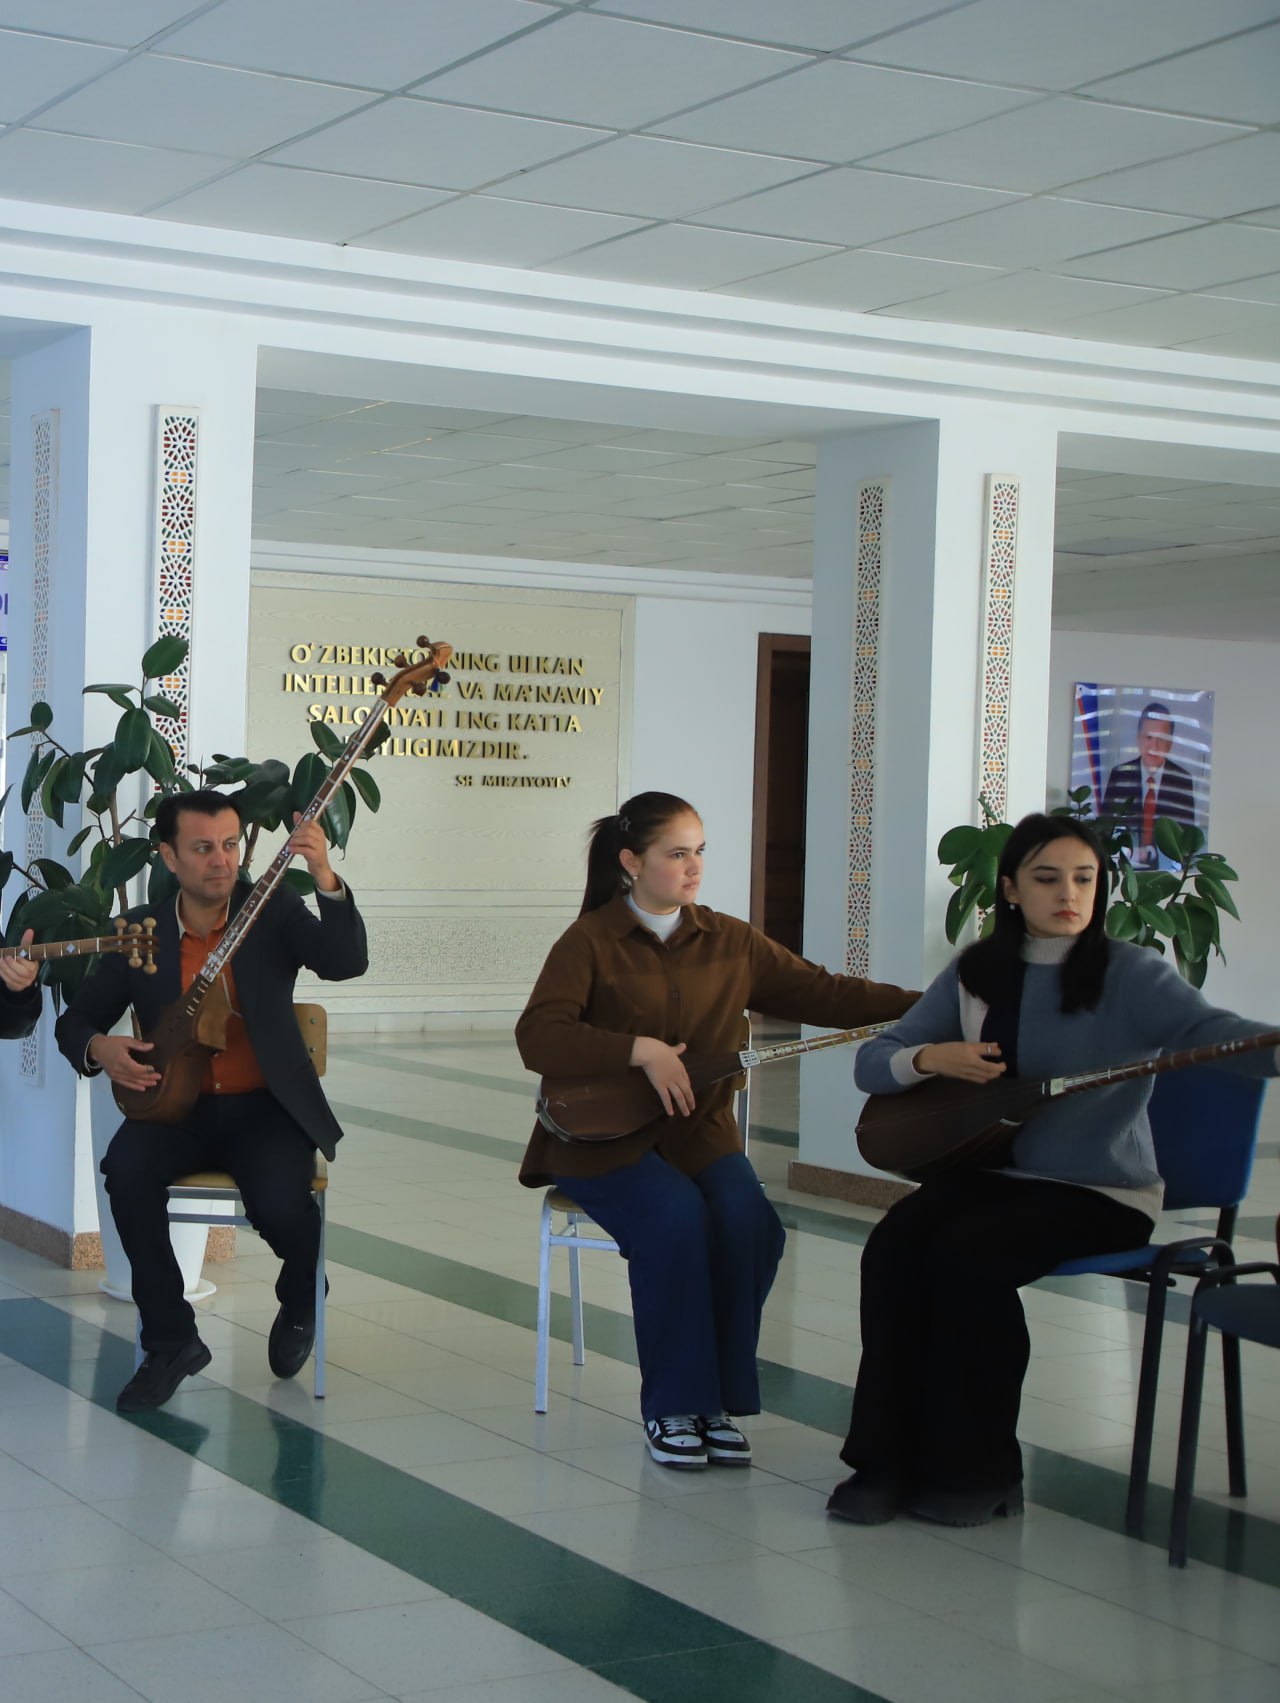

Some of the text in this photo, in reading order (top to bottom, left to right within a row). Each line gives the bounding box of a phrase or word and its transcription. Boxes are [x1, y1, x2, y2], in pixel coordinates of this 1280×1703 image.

[508, 655, 585, 675] ULKAN
[457, 681, 488, 699] VA
[456, 710, 500, 730] ENG
[508, 713, 582, 732] KATTA
